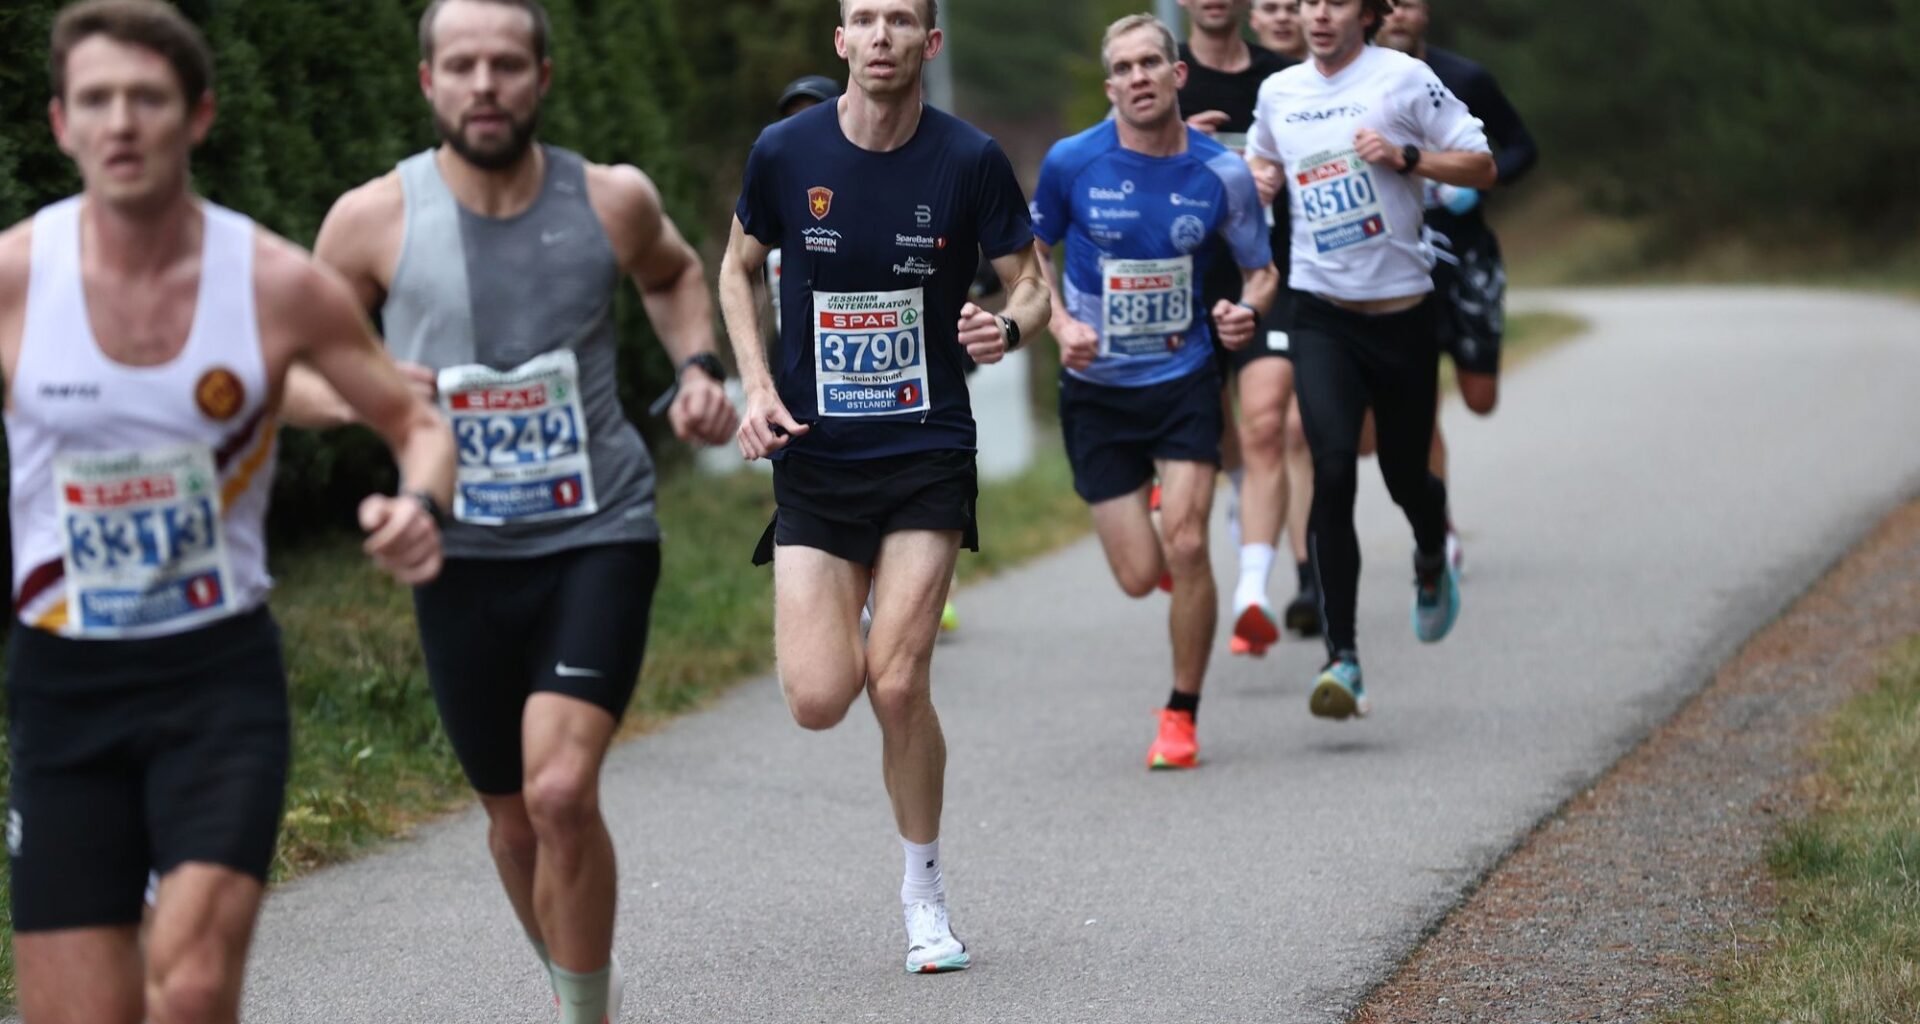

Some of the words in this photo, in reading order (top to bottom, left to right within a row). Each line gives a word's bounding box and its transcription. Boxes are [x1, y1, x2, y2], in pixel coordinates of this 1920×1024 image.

[1286, 107, 1348, 123] CRAFT
[1303, 174, 1371, 222] 3510
[805, 236, 837, 247] SPORTEN
[895, 233, 934, 244] SpareBank
[1121, 275, 1173, 289] SPAR
[827, 298, 912, 310] VINTERMARATON
[1111, 289, 1185, 324] 3818
[833, 314, 897, 327] SPAR
[824, 330, 915, 372] 3790
[467, 384, 546, 410] SPAR
[829, 388, 896, 402] SpareBank
[903, 386, 912, 402] 1
[846, 399, 897, 409] ØSTLANDET
[457, 408, 577, 466] 3242
[67, 502, 209, 571] 3313
